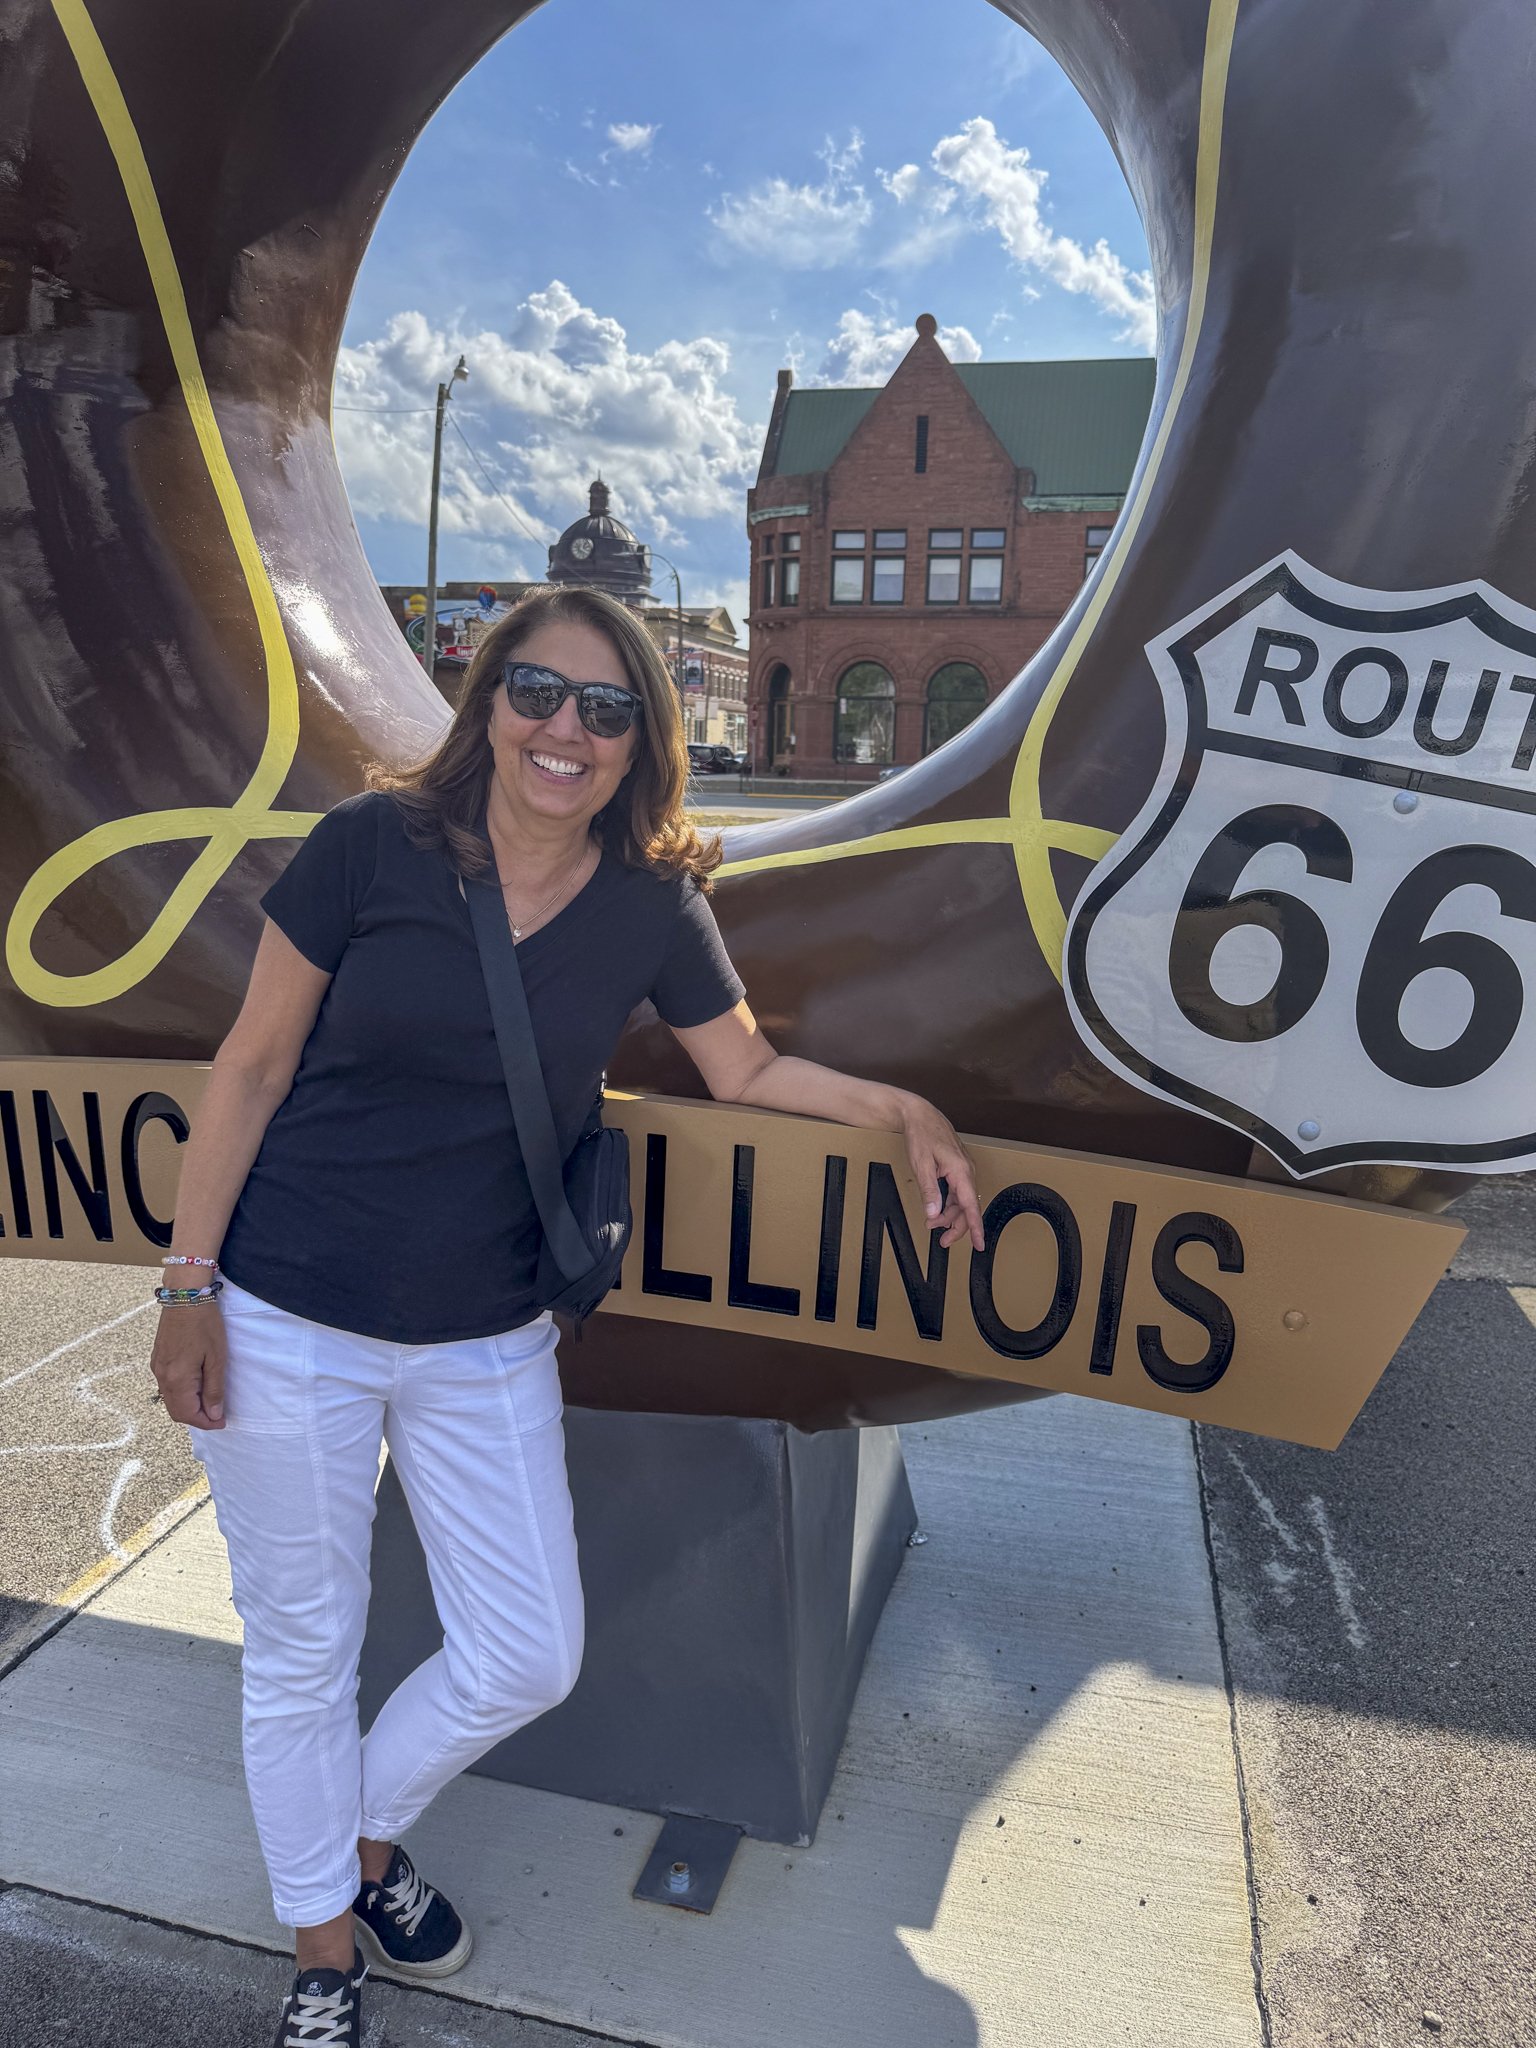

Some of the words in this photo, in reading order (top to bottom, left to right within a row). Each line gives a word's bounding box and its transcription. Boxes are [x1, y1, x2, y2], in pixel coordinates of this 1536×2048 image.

[1168, 803, 1536, 1089] 66
[0, 1089, 191, 1249] INC
[603, 1127, 1245, 1394] LLINOIS
